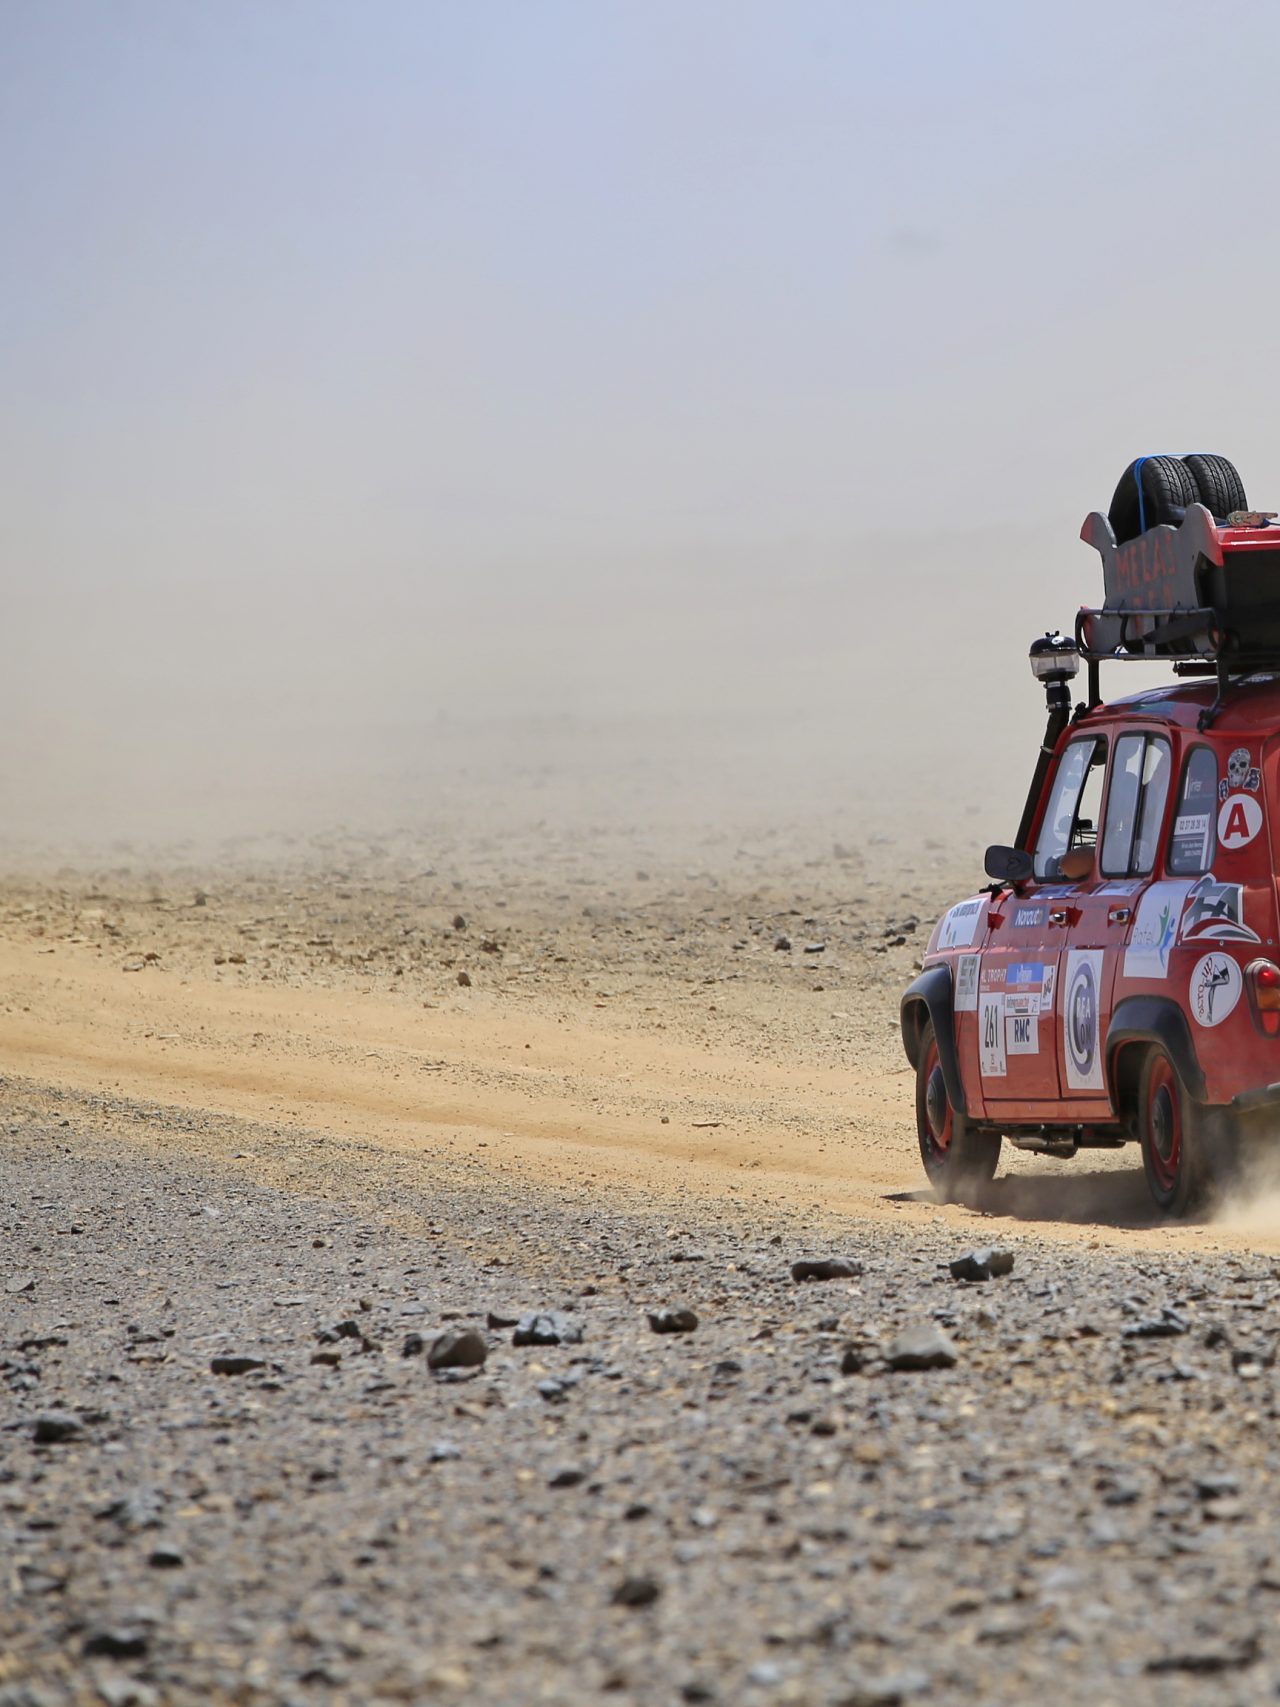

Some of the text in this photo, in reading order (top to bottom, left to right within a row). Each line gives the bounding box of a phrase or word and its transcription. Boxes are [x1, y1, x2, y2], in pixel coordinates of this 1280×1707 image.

[1223, 803, 1250, 840] A
[984, 1003, 999, 1049] 261
[1014, 1018, 1030, 1043] RMC
